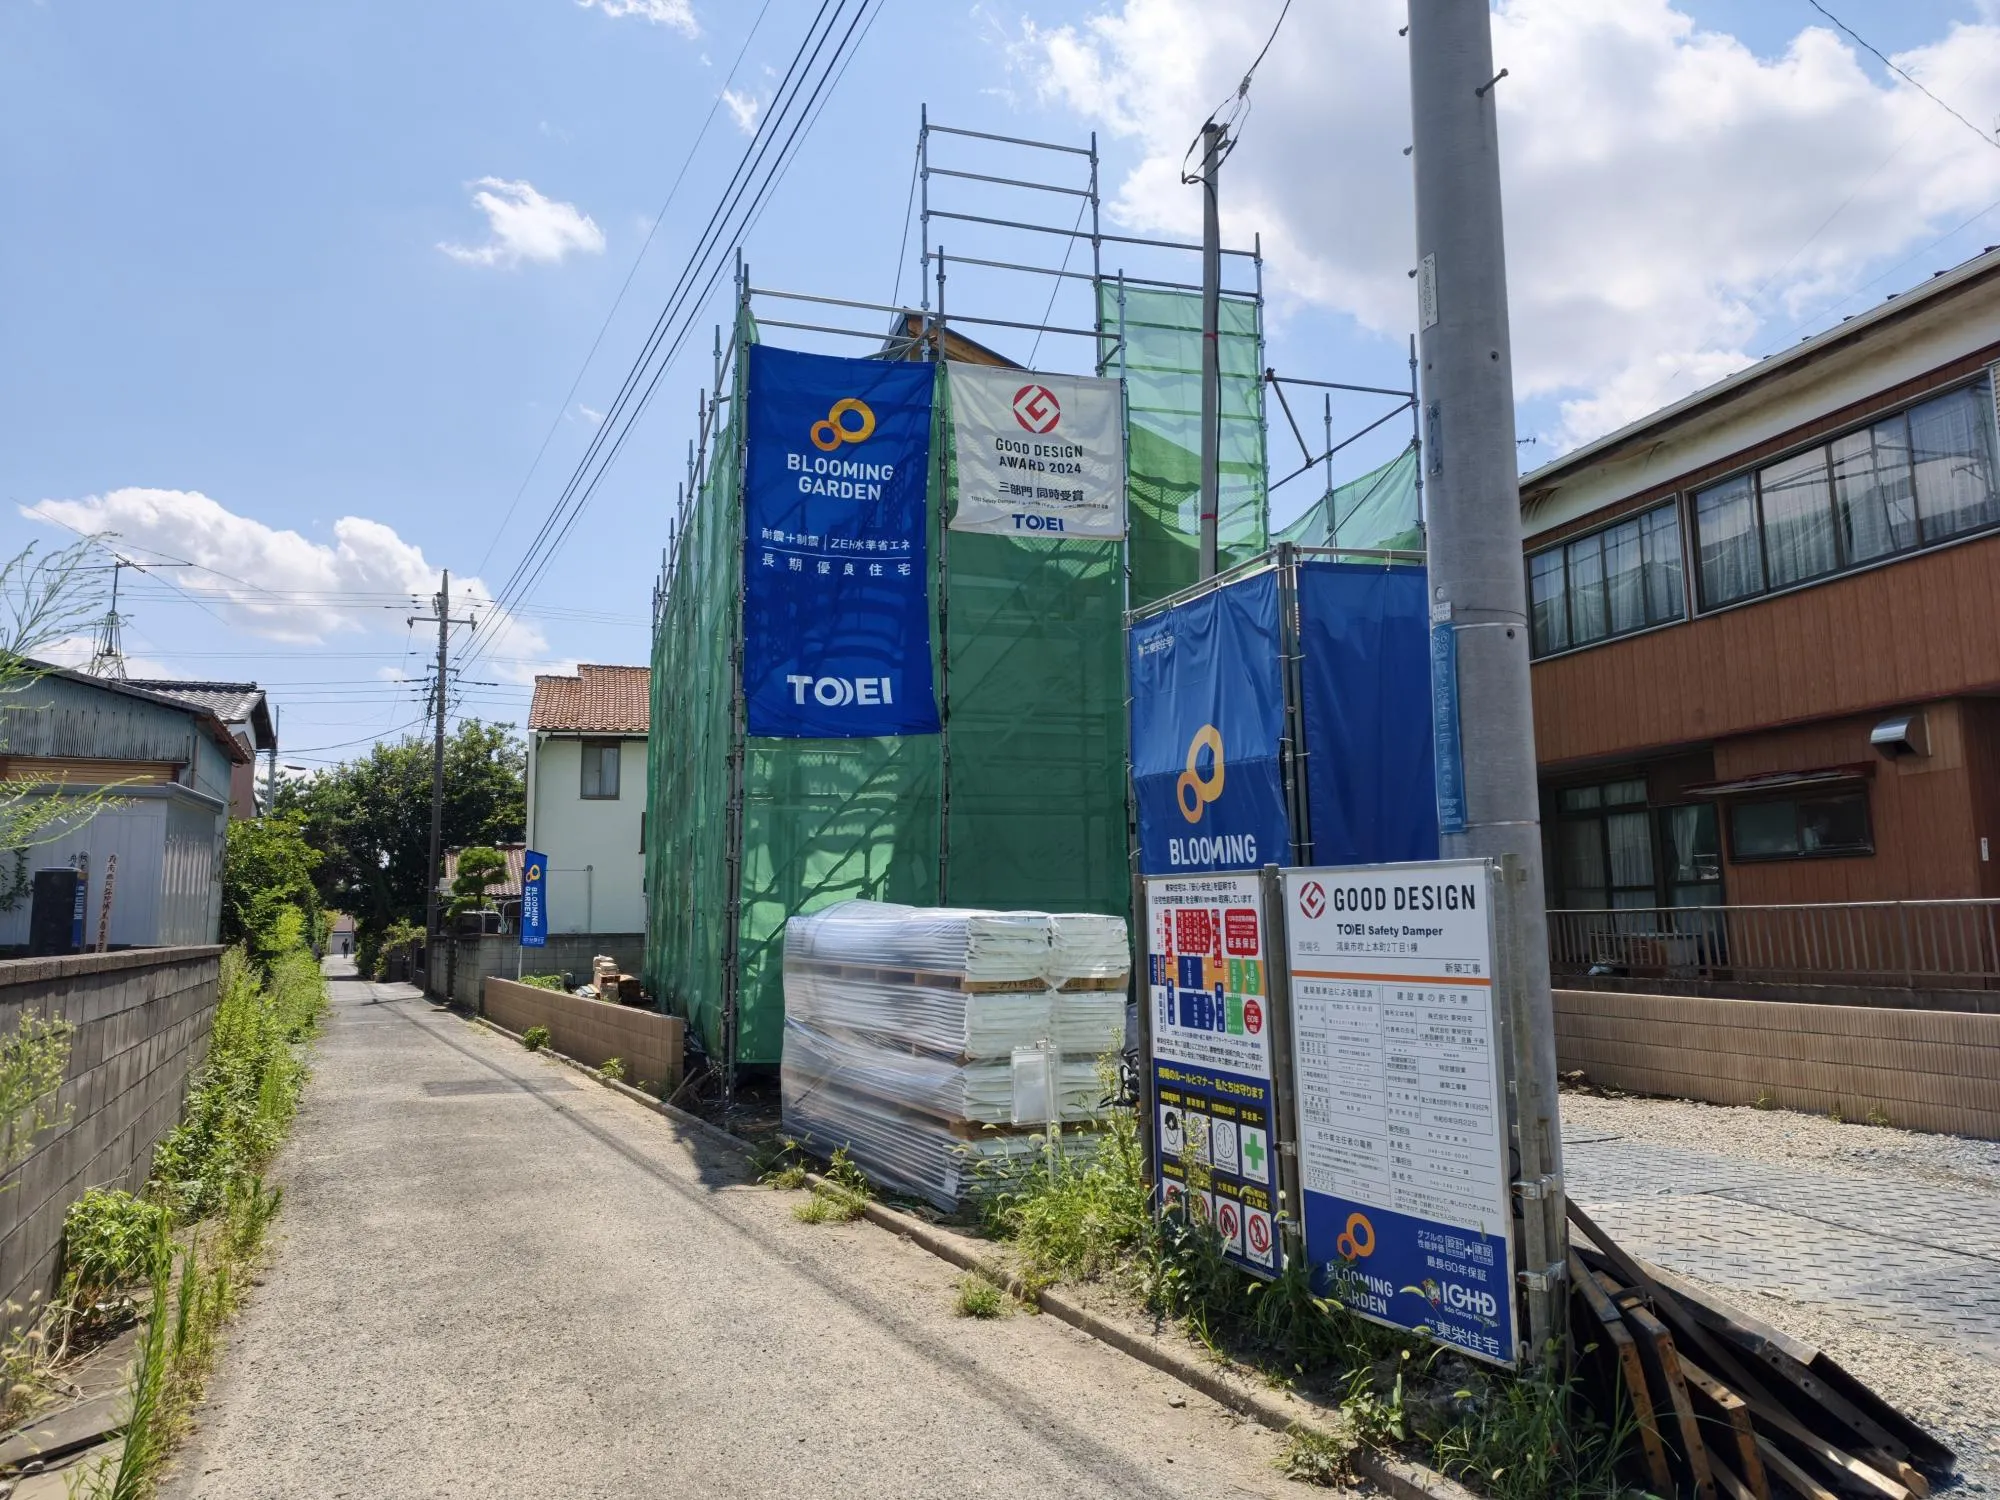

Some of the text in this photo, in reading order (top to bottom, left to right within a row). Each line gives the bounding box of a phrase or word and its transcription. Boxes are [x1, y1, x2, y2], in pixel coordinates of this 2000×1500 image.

[996, 437, 1083, 458] GOOD DESIGN
[787, 453, 894, 480] BLOOMING
[999, 456, 1082, 474] AWARD 2024
[798, 476, 882, 500] GARDEN
[998, 481, 1084, 502] 三部門 同時受賞
[762, 553, 911, 576] 長期優良住宅
[787, 674, 892, 706] TOEI
[1169, 833, 1257, 866] BLOOMING
[1334, 884, 1476, 912] GOOD DESIGN
[1368, 926, 1399, 938] Safety
[1402, 926, 1443, 938] Damper
[1445, 963, 1481, 975] 新築工事
[1241, 1109, 1263, 1122] 安全第一
[1391, 1156, 1412, 1166] 工事担当
[1246, 1197, 1269, 1210] 立入禁止
[1417, 1230, 1444, 1242] ダブルの
[1418, 1240, 1445, 1254] 性能評価
[1427, 1256, 1487, 1282] 最長60年保証
[1437, 1321, 1499, 1355] 東栄住宅
